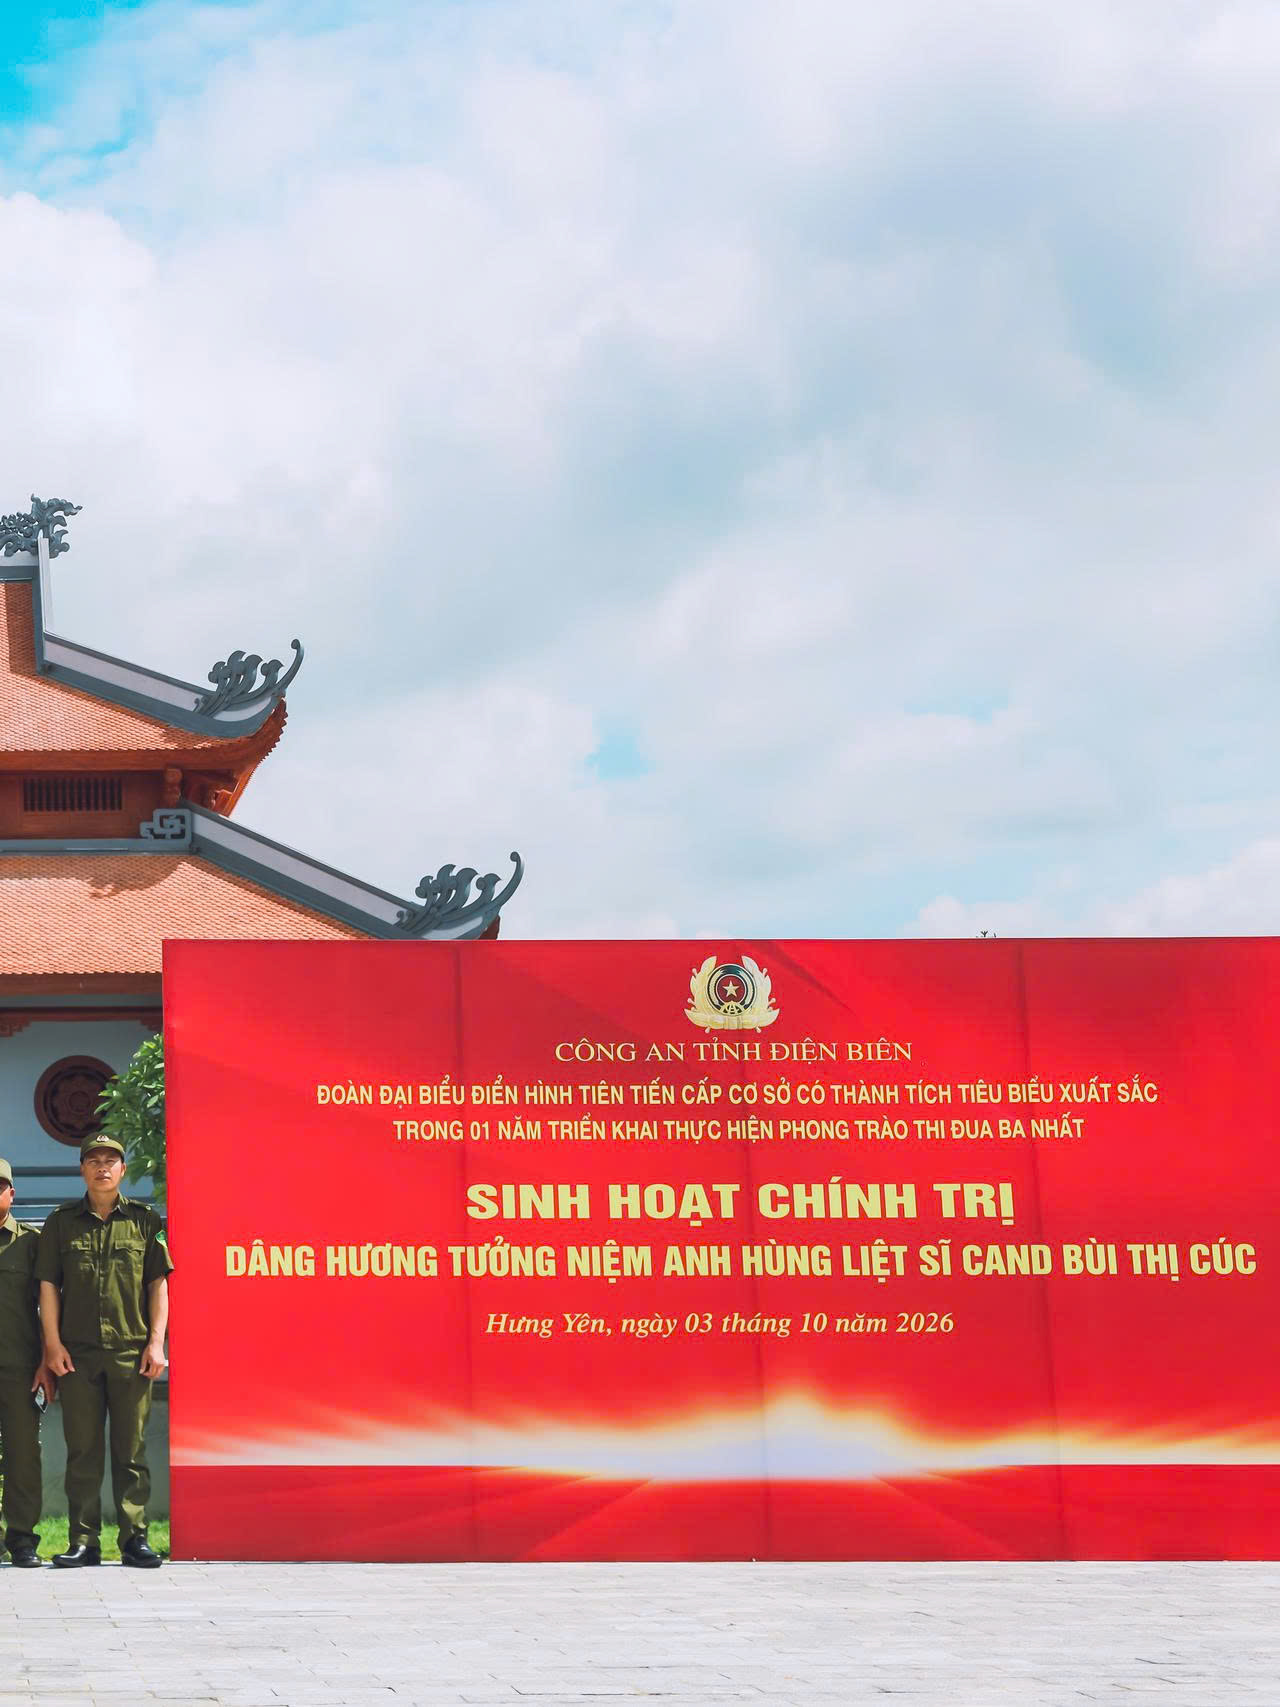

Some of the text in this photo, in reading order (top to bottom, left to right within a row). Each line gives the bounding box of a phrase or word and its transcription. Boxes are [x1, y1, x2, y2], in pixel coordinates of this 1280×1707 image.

[556, 1037, 912, 1064] CÔNG AN TỈNH ĐIỆN BIÊN
[317, 1074, 1157, 1108] ĐOÀN ĐẠI BIỂU ĐIỂN HÌNH TIÊN TIẾN CẤP CƠ SỞ CÓ THÀNH TÍCH TIÊU BIỂU XUẤT SẮC
[393, 1112, 1084, 1144] TRONG 01 NĂM TRIỂN KHAI THỰC HIỆN PHONG TRÀO THI ĐUA BA NHẤT
[467, 1176, 1014, 1226] SINH HOẠT CHÍNH TRỊ
[226, 1236, 1256, 1283] DÂNG HƯƠNG TƯỞNG NIỆM ANH HÙNG LIỆT SĨ CAND BÙI THỊ CÚC
[486, 1313, 953, 1338] Hưng Yên, ngày 03 tháng 10 năm 2026
